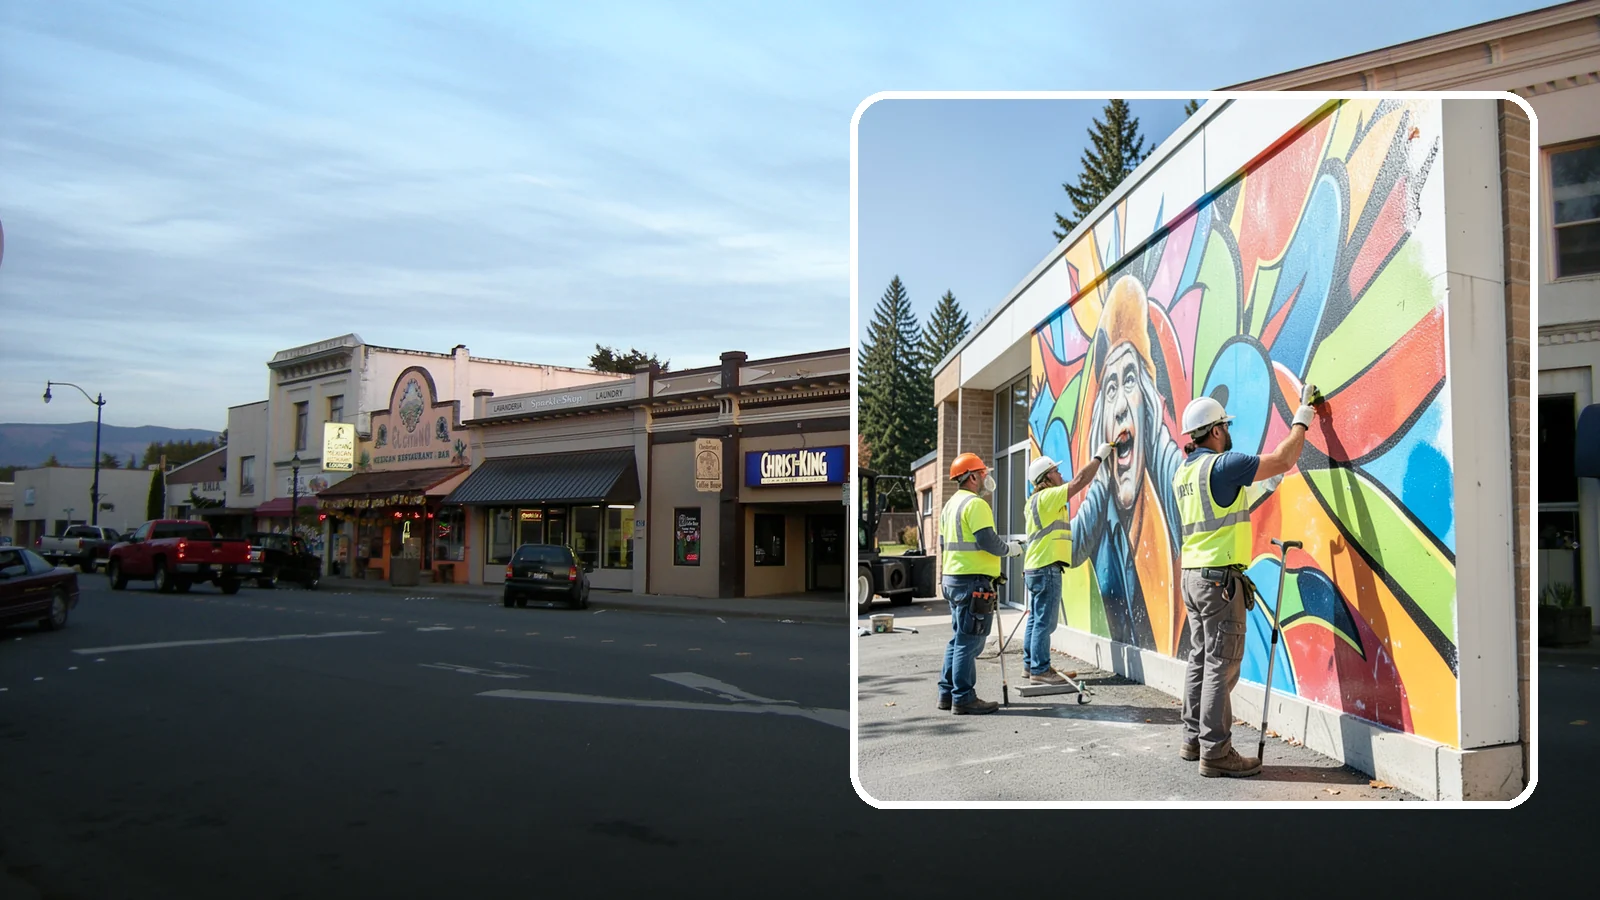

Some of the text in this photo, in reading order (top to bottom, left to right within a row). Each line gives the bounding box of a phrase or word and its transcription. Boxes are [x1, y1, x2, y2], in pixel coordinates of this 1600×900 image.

[494, 389, 623, 413] LAVANDERIA Sparkle Shop LAUNDRY
[374, 454, 396, 464] MEXICAN
[398, 451, 434, 463] RESTAURANT
[438, 450, 450, 459] BAR
[761, 450, 827, 478] CHRIST KING
